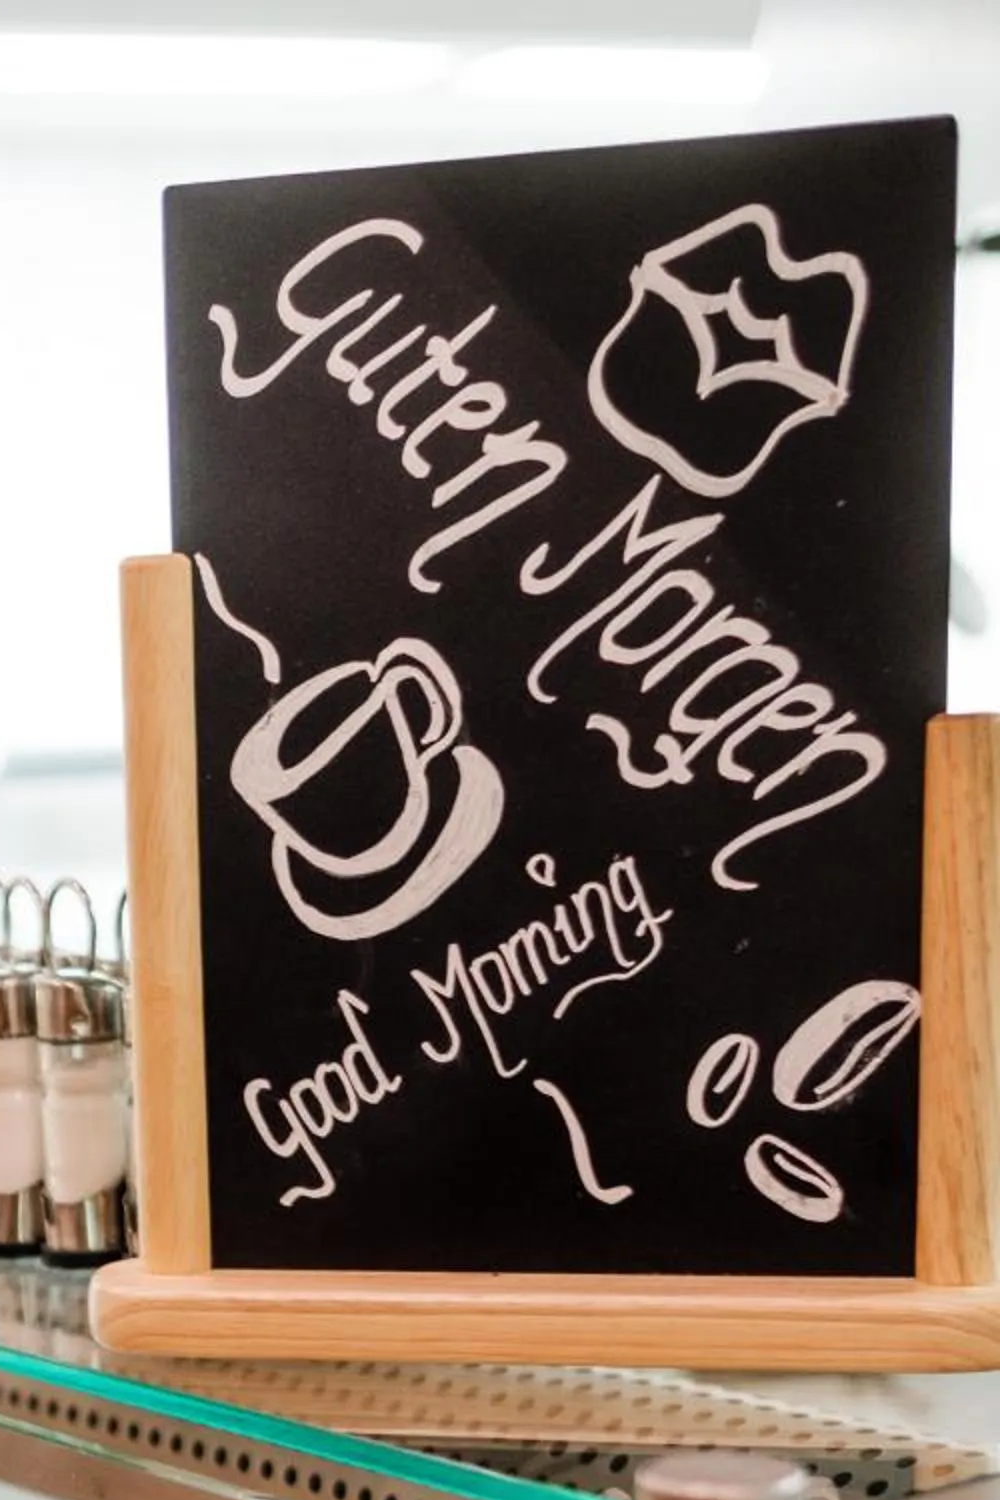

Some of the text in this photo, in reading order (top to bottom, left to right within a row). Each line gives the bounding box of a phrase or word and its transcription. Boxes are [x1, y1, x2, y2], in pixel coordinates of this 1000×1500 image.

[208, 217, 889, 893] Guten Morgen
[242, 852, 673, 1207] Good Morning
